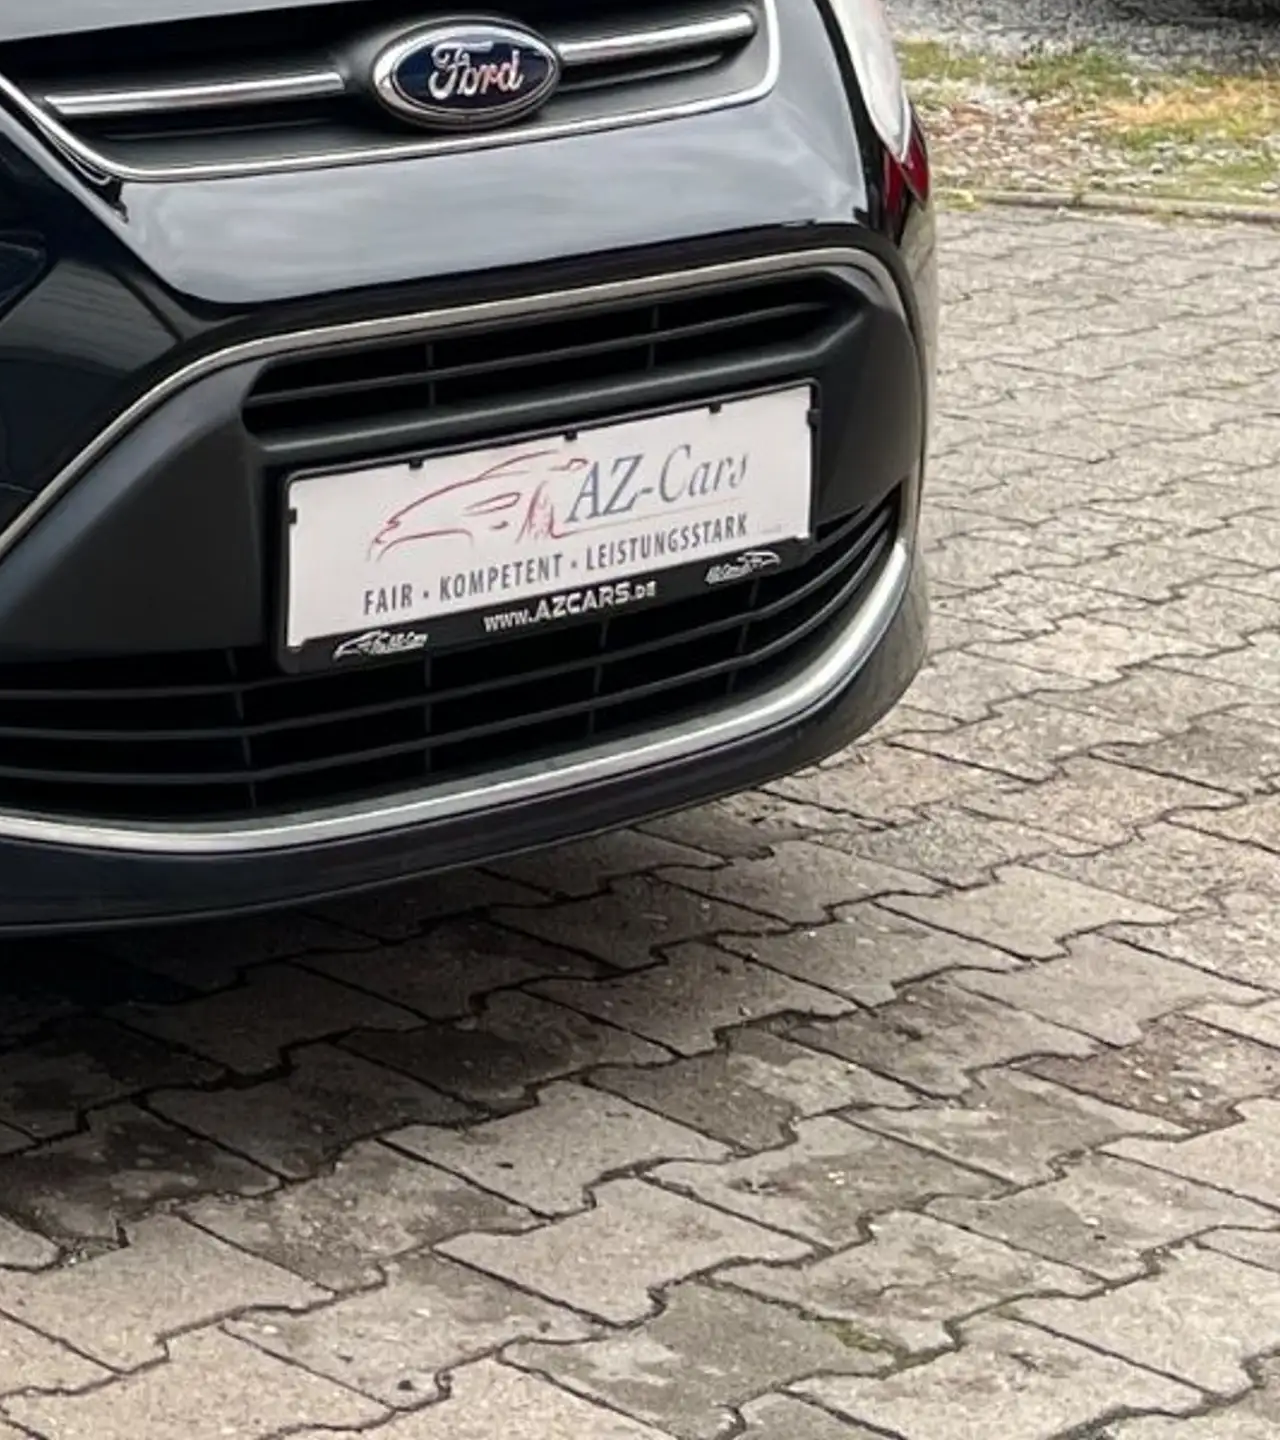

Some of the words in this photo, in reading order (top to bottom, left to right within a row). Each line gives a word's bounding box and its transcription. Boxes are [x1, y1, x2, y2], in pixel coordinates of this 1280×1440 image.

[428, 40, 525, 100] Ford
[563, 444, 748, 525] AZ-Cars
[363, 585, 413, 616] FAIR
[439, 554, 563, 602] KOMPETENT
[585, 512, 748, 571] LEISTUNGSSTARK
